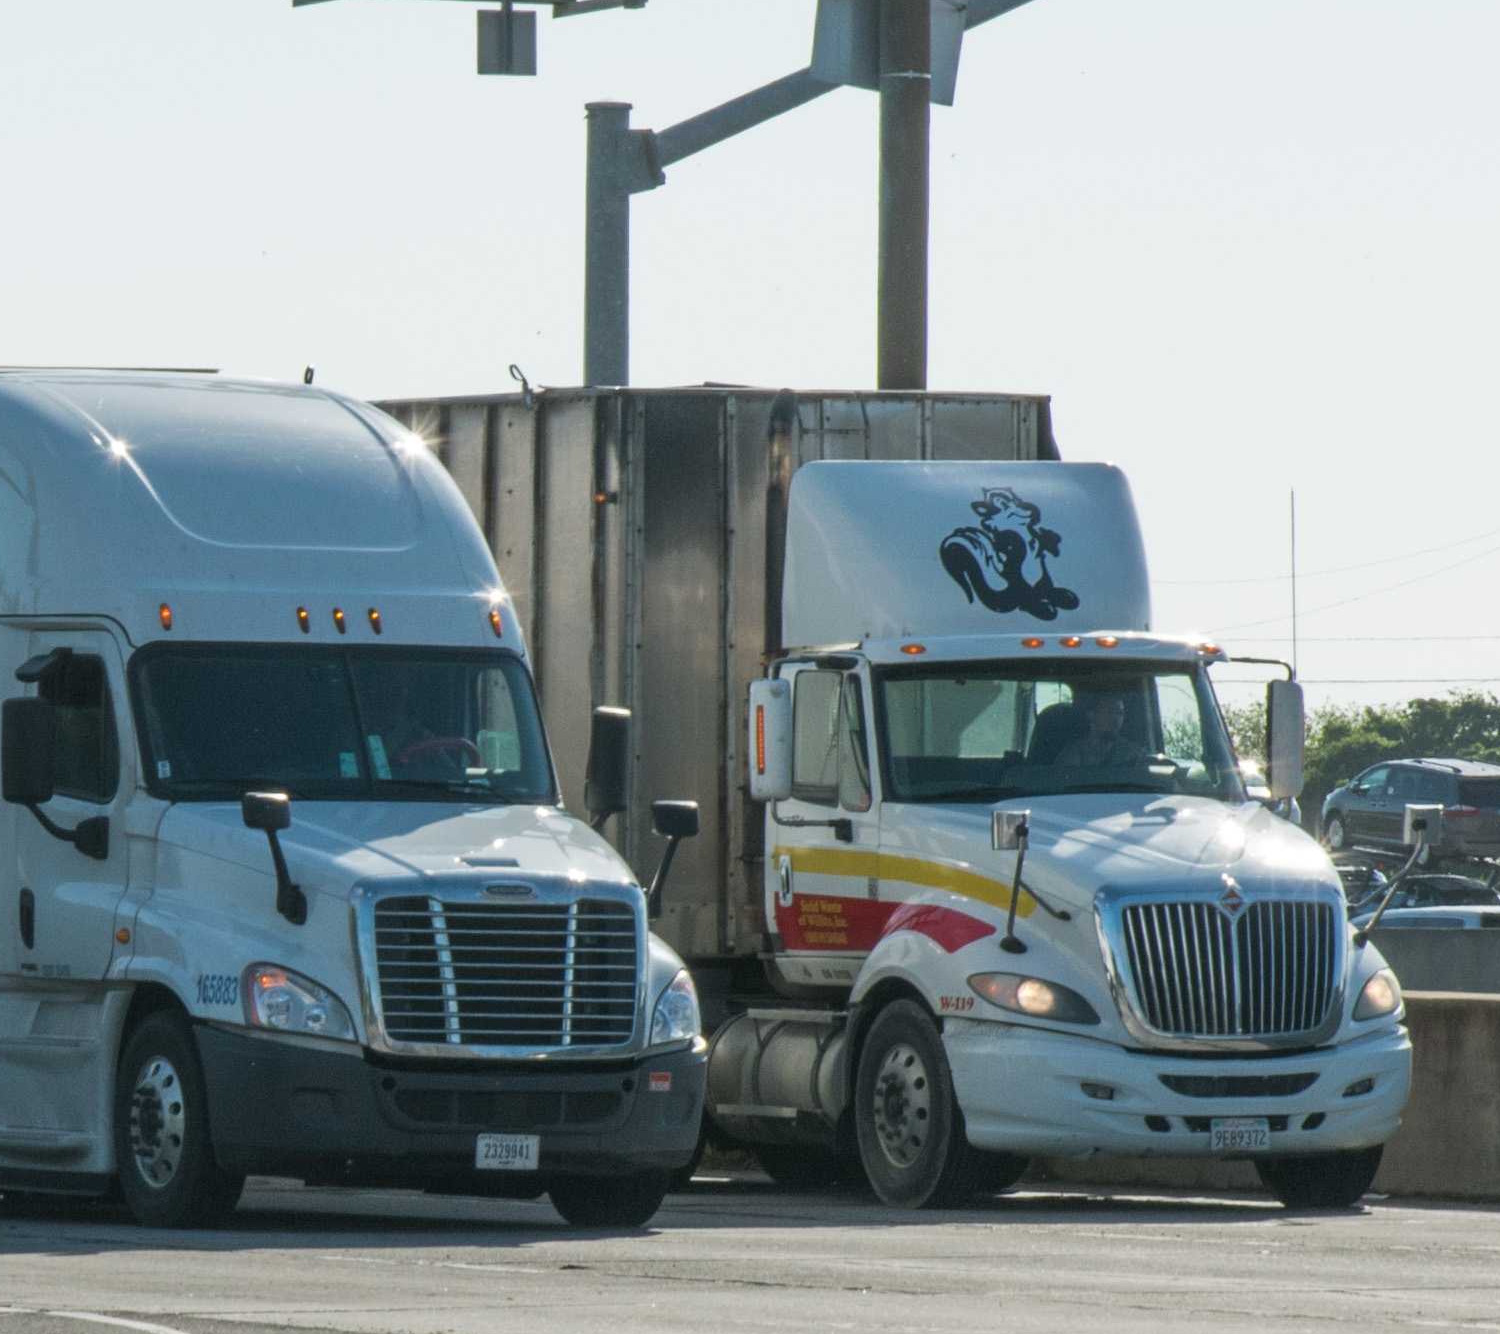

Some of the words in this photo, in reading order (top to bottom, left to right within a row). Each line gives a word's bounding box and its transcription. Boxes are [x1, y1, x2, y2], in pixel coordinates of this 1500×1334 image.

[197, 974, 239, 1005] 165883
[940, 996, 974, 1011] W-119
[1215, 1129, 1266, 1147] 9E89372
[485, 1143, 530, 1160] 2329941
